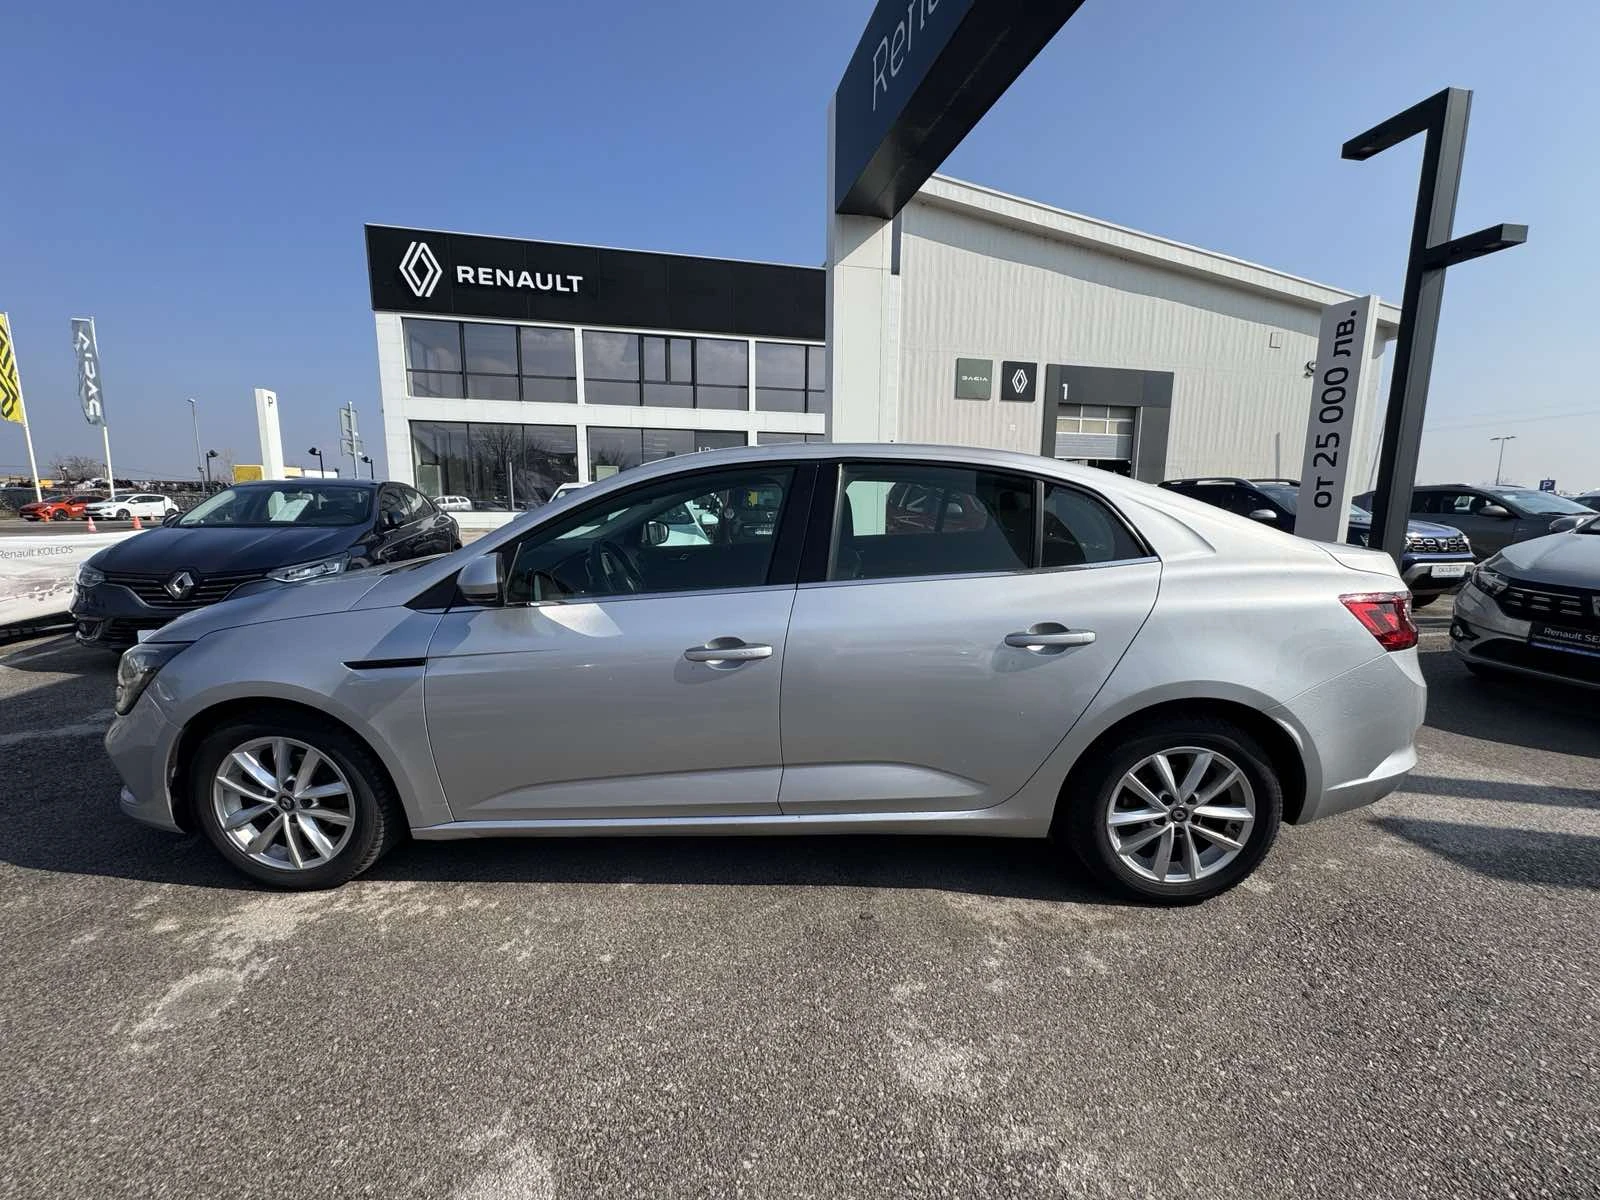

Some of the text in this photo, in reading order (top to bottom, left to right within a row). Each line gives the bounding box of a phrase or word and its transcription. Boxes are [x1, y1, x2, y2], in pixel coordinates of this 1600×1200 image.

[456, 265, 583, 293] RENAULT
[1062, 383, 1069, 400] 1
[1318, 367, 1348, 424] 000
[267, 396, 274, 407] P
[1313, 432, 1340, 468] 25
[1543, 481, 1552, 489] P
[0, 545, 73, 559] Renault KOLEOS
[1544, 627, 1600, 643] Renault SE
